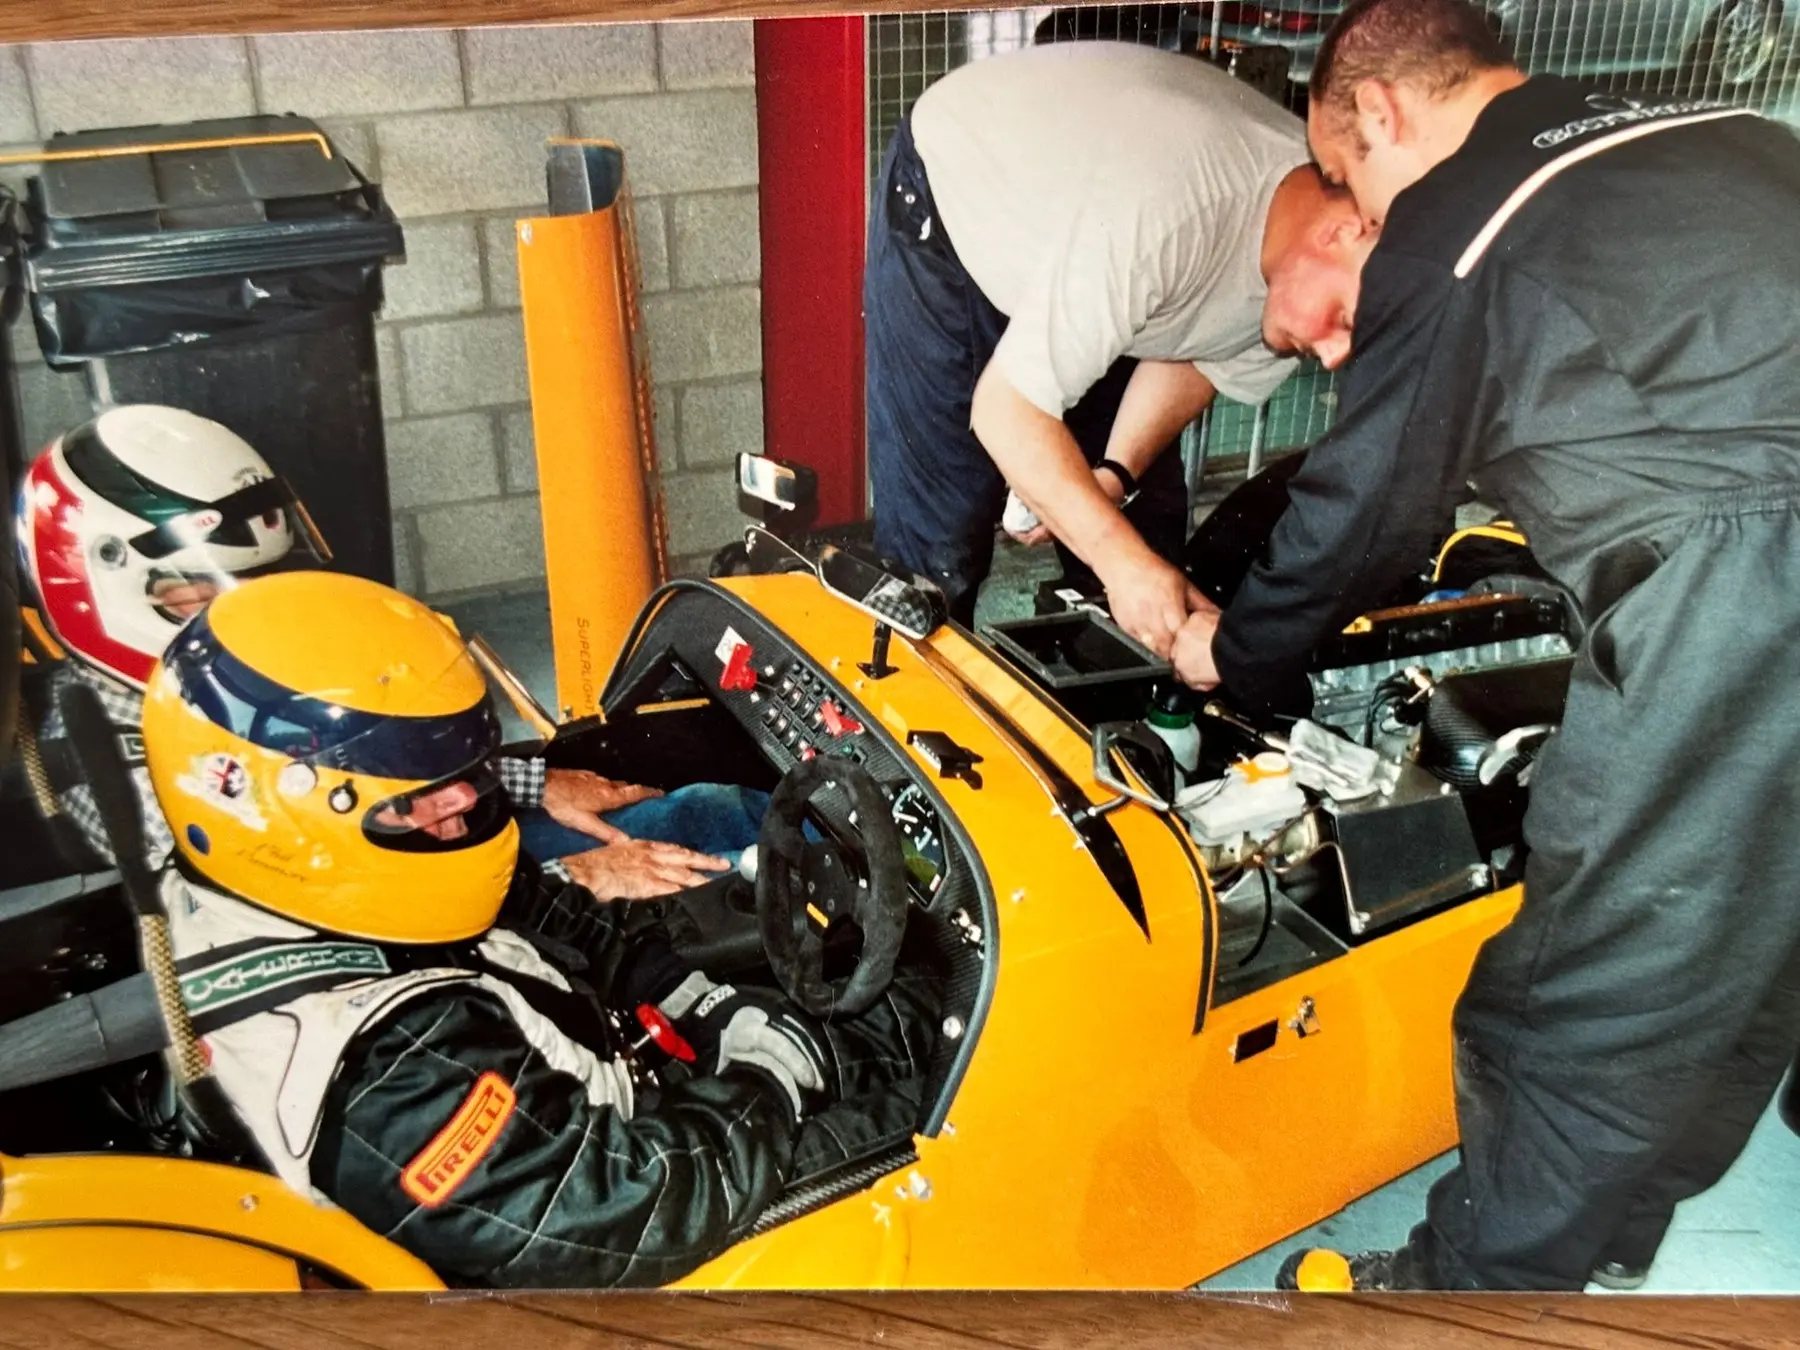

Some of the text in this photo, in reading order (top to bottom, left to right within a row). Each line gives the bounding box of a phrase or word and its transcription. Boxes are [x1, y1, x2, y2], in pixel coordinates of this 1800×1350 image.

[576, 615, 596, 712] SUPERLIGHT
[184, 948, 379, 1001] CATERHAM
[415, 1083, 506, 1195] PIRELLI
